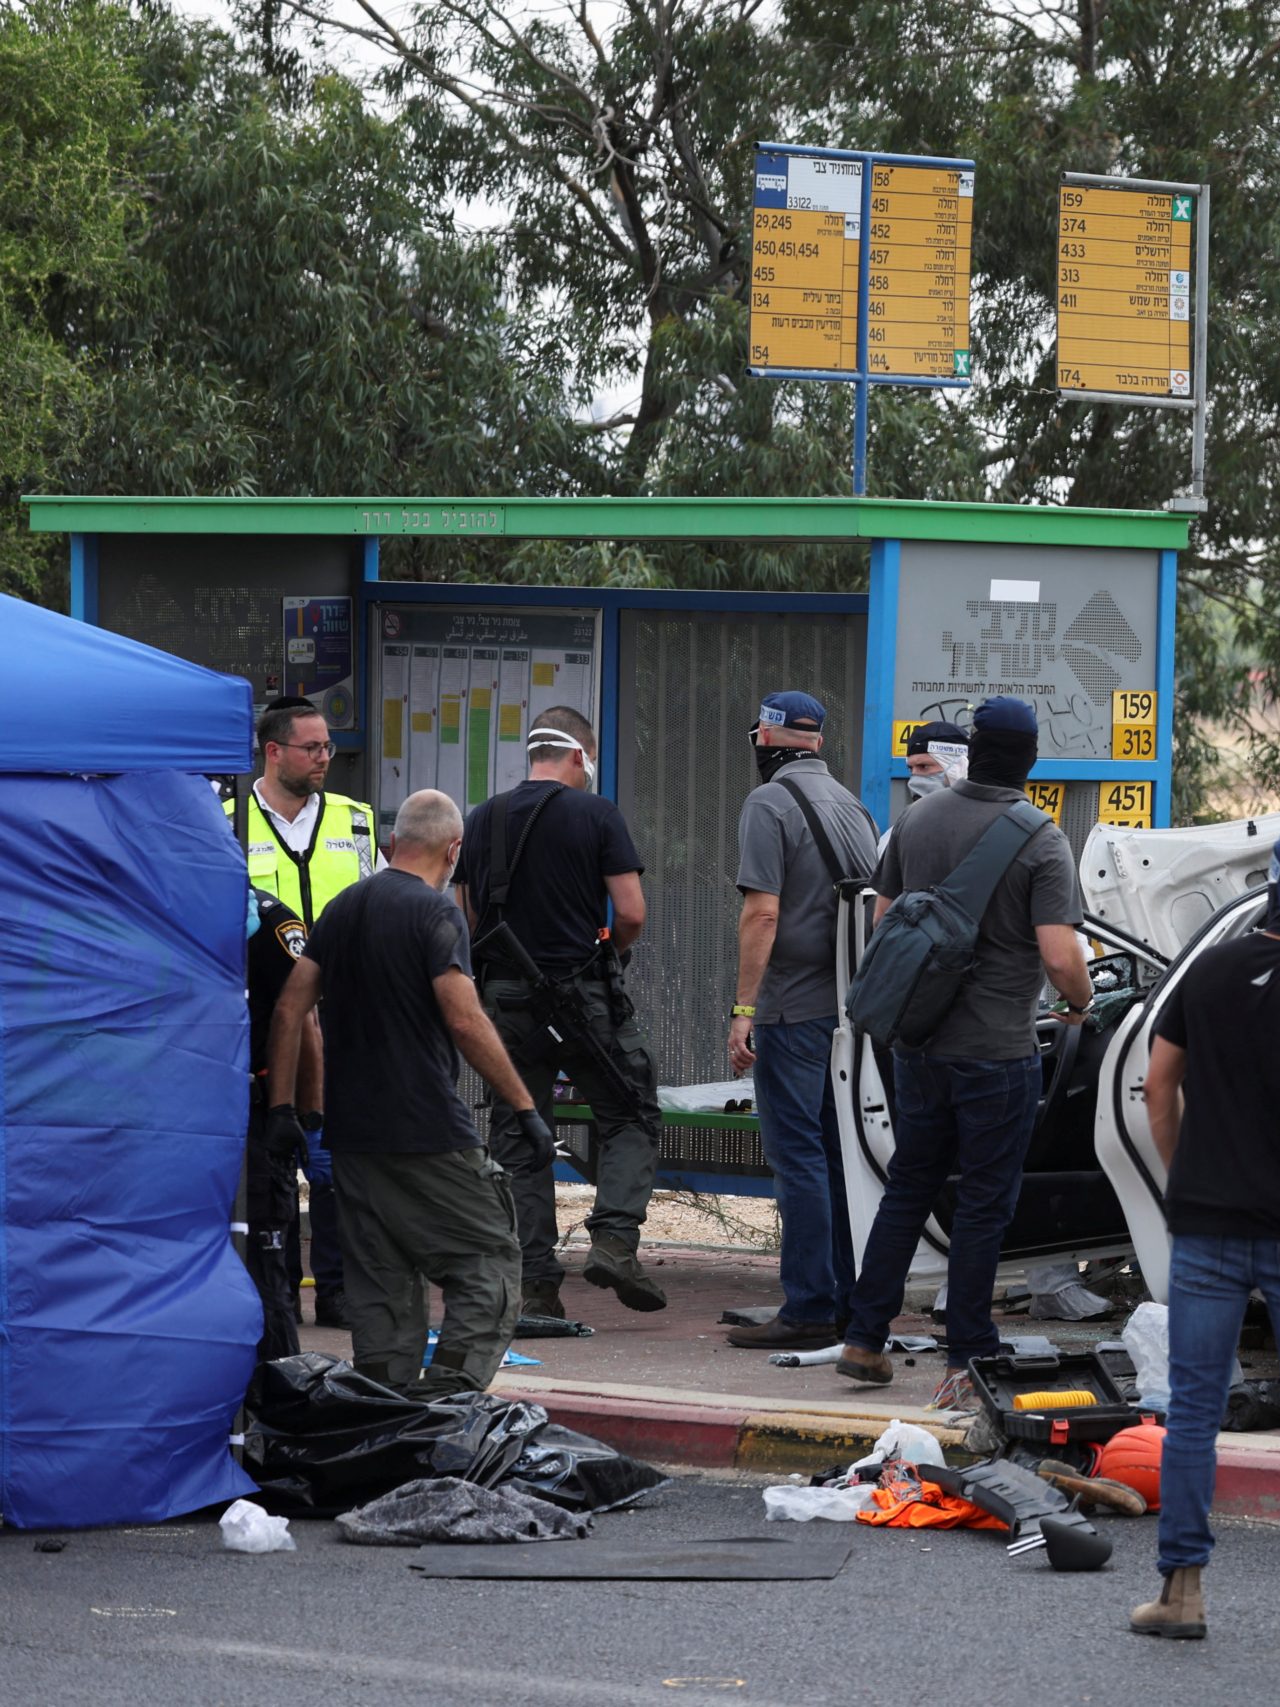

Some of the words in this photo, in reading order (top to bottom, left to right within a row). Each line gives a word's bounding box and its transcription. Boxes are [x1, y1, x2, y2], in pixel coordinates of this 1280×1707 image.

[813, 161, 827, 174] צבי
[829, 163, 841, 175] ניר
[841, 163, 862, 176] צומת
[873, 172, 890, 187] 158
[788, 196, 811, 210] 33122
[872, 198, 889, 213] 451
[938, 197, 957, 210] רמלה
[1062, 192, 1083, 207] 159
[1147, 195, 1171, 208] רמלה
[755, 214, 792, 232] 29,245
[824, 214, 844, 227] רמלה
[1062, 218, 1086, 233] 374
[1146, 220, 1170, 233] רמלה
[870, 224, 891, 239] 452
[936, 223, 956, 236] רמלה
[755, 240, 820, 260] 450,451,454
[935, 249, 955, 261] רמלה
[1061, 243, 1086, 258] 433
[1135, 245, 1169, 258] ירושלים
[869, 250, 890, 264] 457
[754, 266, 775, 281] 455
[934, 274, 954, 286] רמלה
[1061, 268, 1080, 283] 313
[1144, 270, 1169, 283] רמלה
[869, 275, 889, 290] 458
[752, 292, 770, 308] 134
[803, 291, 822, 303] עילית
[824, 293, 841, 304] ביתר
[1060, 293, 1077, 308] 411
[1128, 295, 1151, 306] שמש
[1153, 297, 1168, 308] בית
[868, 302, 885, 316] 461
[942, 300, 954, 312] לוד
[772, 317, 790, 328] רעות
[791, 318, 814, 329] מכבים
[816, 319, 840, 331] מודיעין
[868, 327, 885, 342] 461
[941, 326, 953, 337] לוד
[752, 345, 769, 360] 154
[914, 352, 938, 364] מודיעין
[939, 352, 954, 363] חבל
[869, 353, 886, 367] 144
[1060, 368, 1081, 383] 174
[1115, 373, 1140, 385] בלבד
[1141, 375, 1169, 387] הורדה
[362, 511, 391, 531] דרך
[401, 510, 431, 528] בכל
[441, 509, 497, 528] להוביל
[320, 605, 339, 620] דרך
[323, 618, 348, 632] שווה
[966, 600, 1057, 641] נתיבי
[574, 628, 592, 636] 33122
[576, 654, 589, 664] 313
[942, 631, 1055, 678] ישראל
[912, 681, 945, 692] תחבורה
[947, 680, 986, 693] לתשתיות
[988, 681, 1025, 694] הלאומית
[1027, 684, 1056, 695] החברה
[1120, 693, 1152, 719] 159
[1122, 728, 1152, 756] 313
[1028, 785, 1060, 813] 154
[1107, 784, 1146, 812] 451
